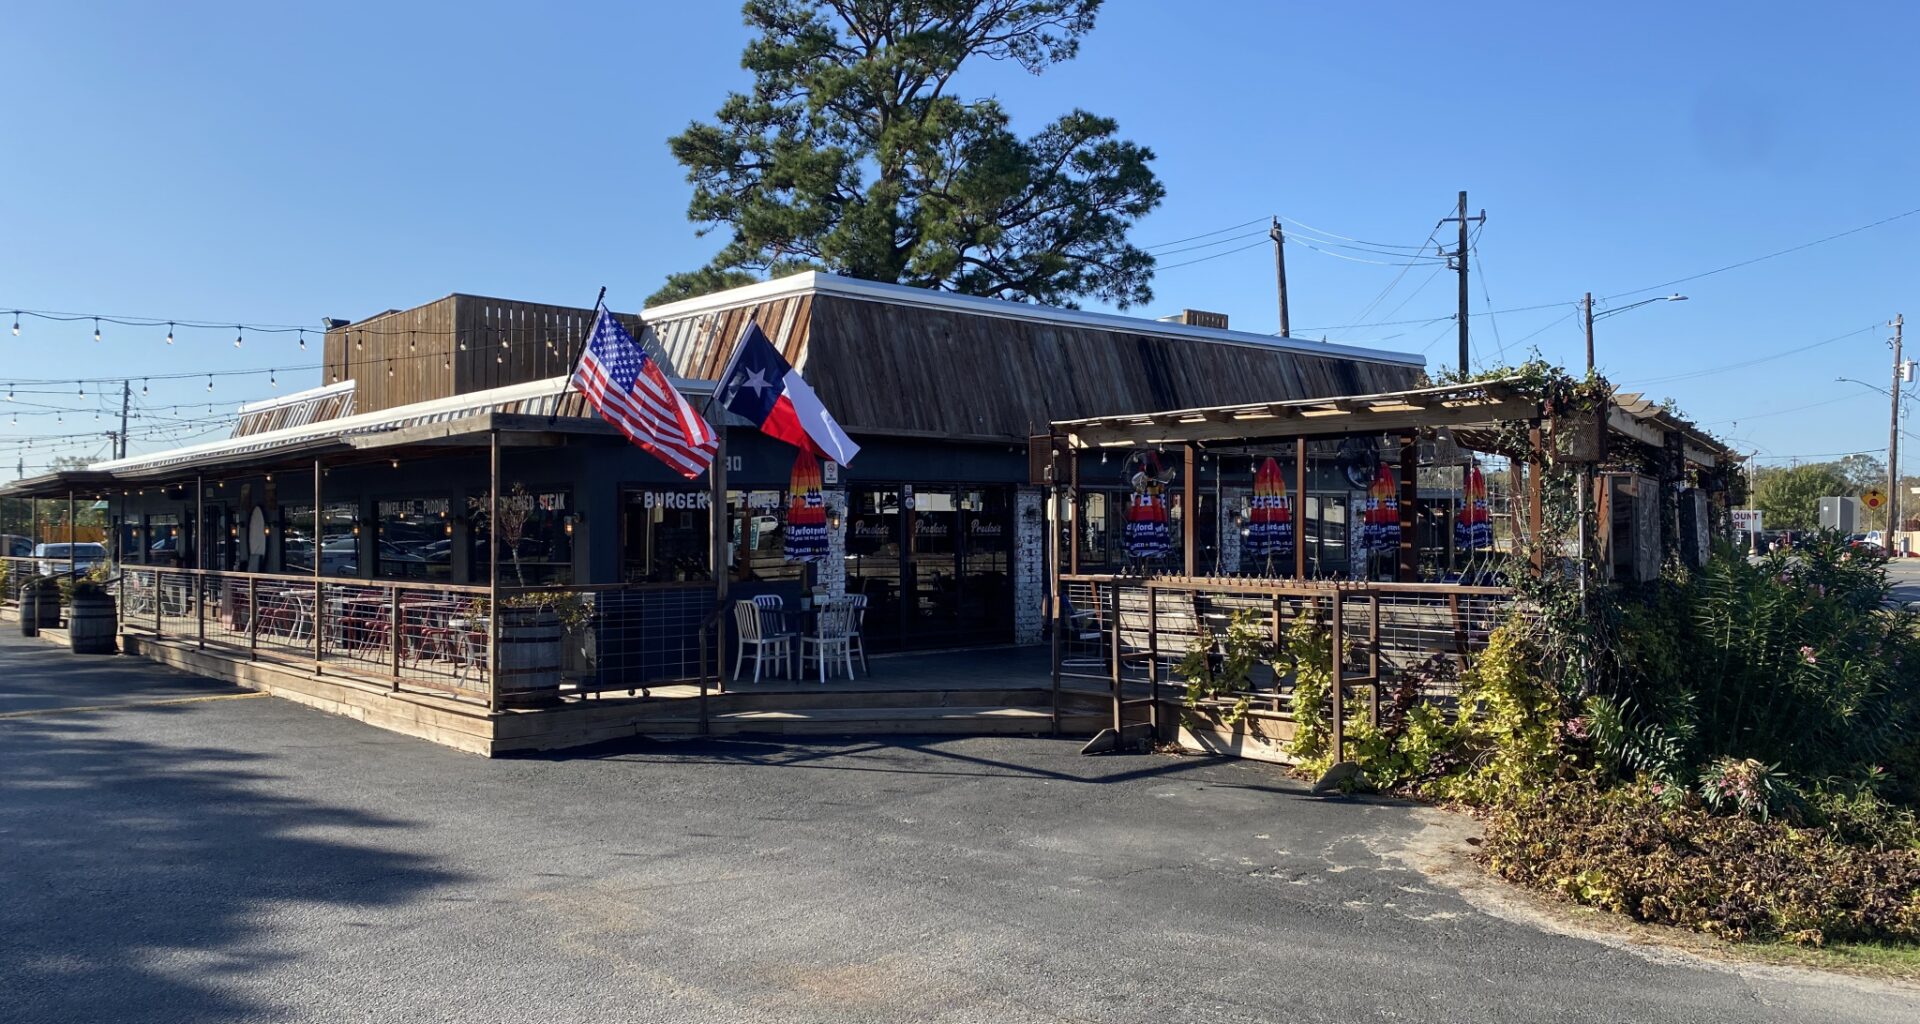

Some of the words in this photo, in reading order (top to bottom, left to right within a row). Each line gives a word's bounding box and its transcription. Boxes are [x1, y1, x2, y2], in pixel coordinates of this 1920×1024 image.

[424, 498, 449, 515] PUDDING
[538, 493, 564, 510] STEAK
[1735, 521, 1746, 529] RE
